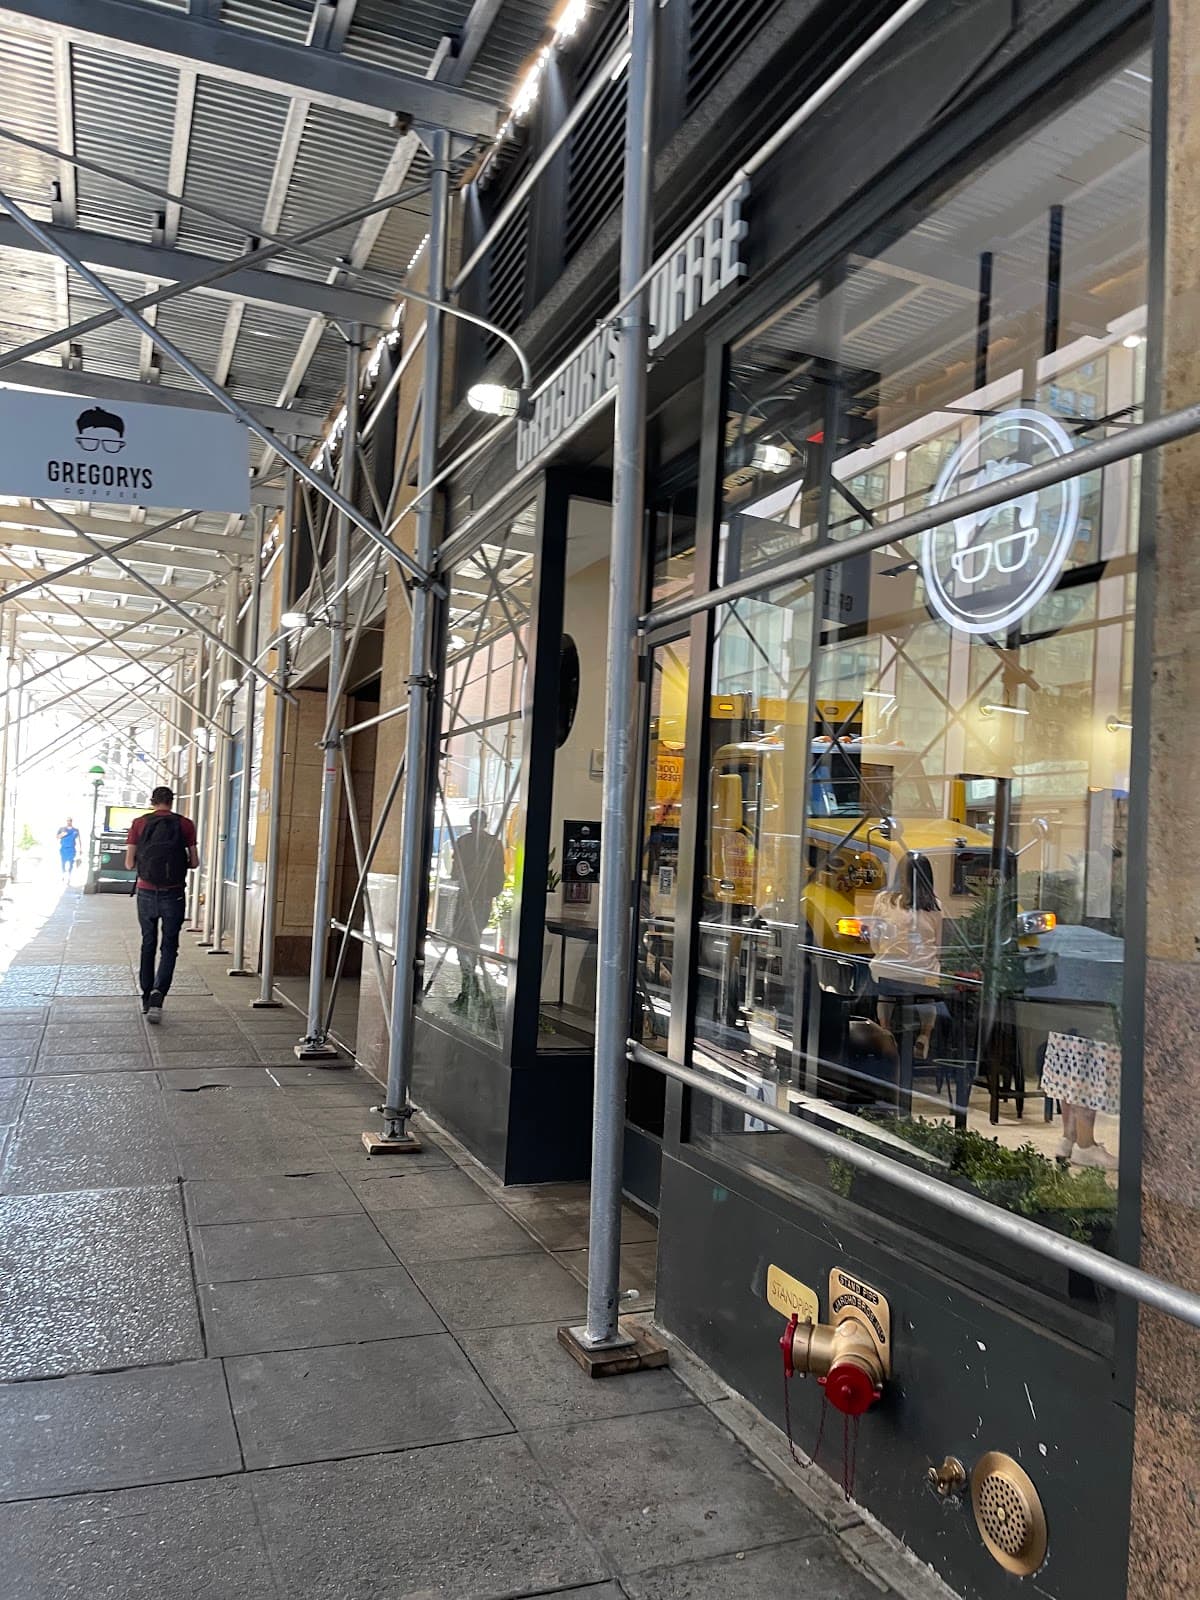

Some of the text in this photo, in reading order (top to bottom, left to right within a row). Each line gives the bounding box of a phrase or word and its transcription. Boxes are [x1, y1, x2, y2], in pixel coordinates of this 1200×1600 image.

[648, 180, 750, 351] OFFEE
[48, 460, 153, 490] GREGORYS
[64, 487, 138, 499] COFFEE
